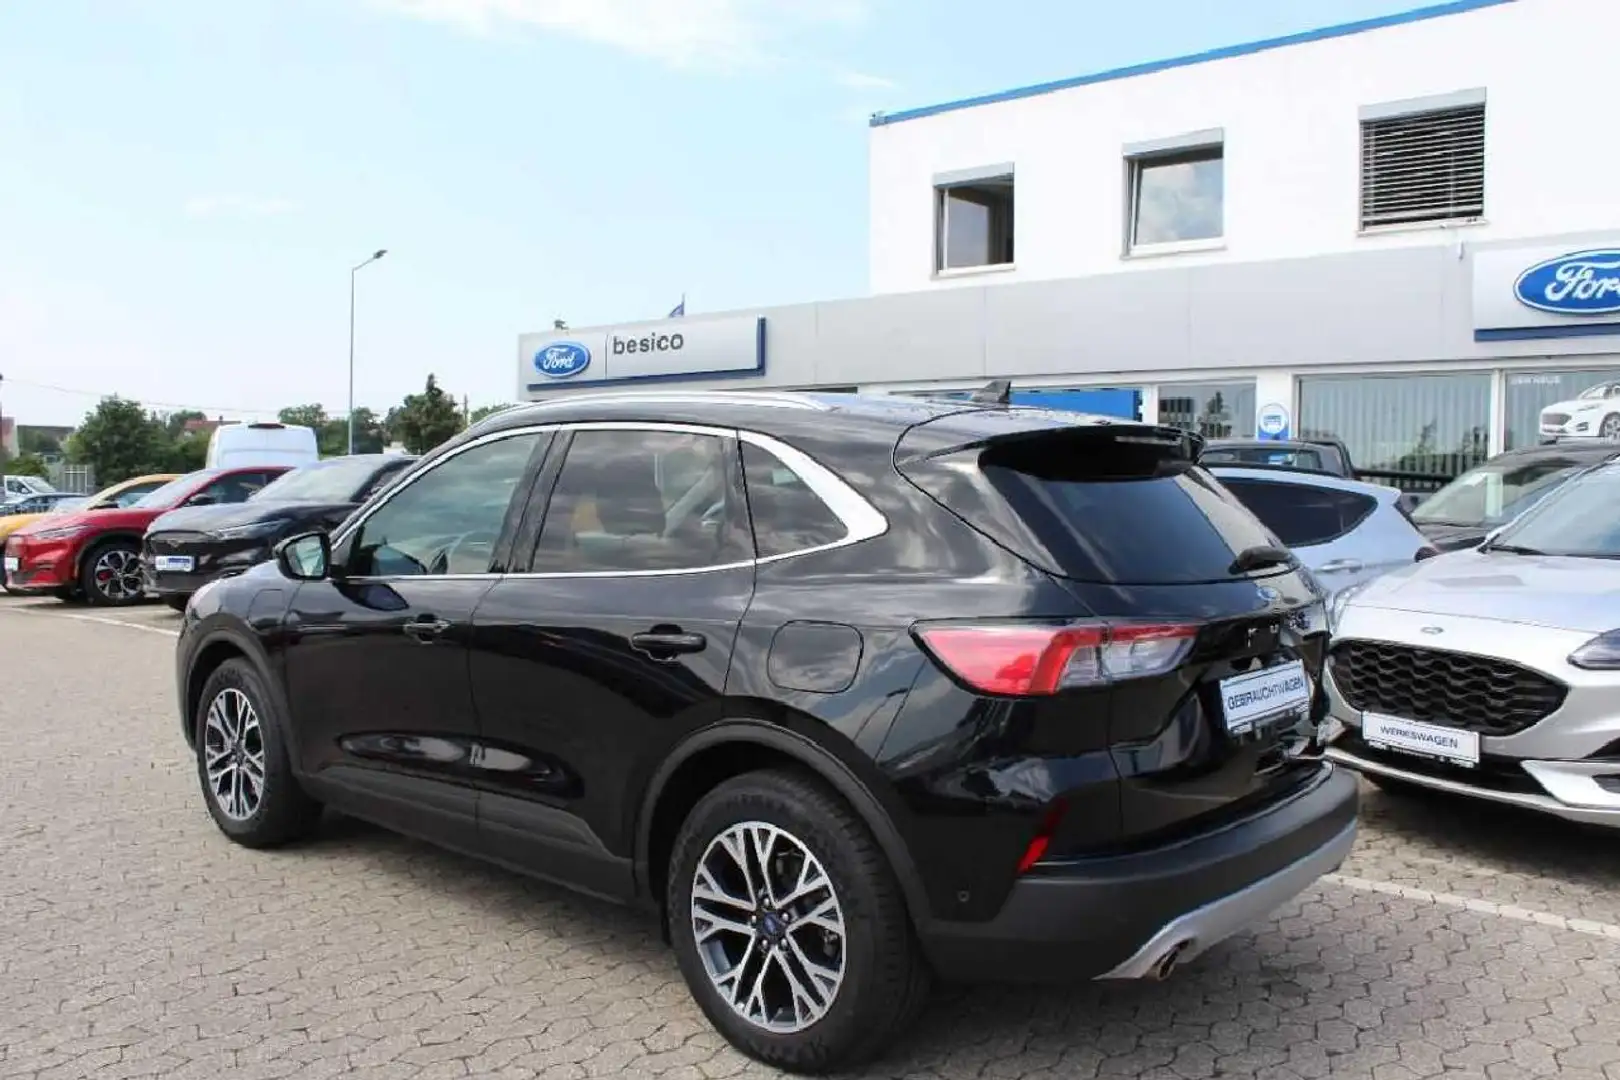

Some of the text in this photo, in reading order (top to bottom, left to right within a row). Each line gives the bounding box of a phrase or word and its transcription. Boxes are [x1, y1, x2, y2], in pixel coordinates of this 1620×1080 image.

[1544, 261, 1620, 301] For
[613, 333, 684, 355] besico
[542, 347, 576, 370] Ford
[1227, 676, 1304, 710] GEBRAUCHTWAGEN
[1380, 725, 1458, 748] WERKSWAGEN
